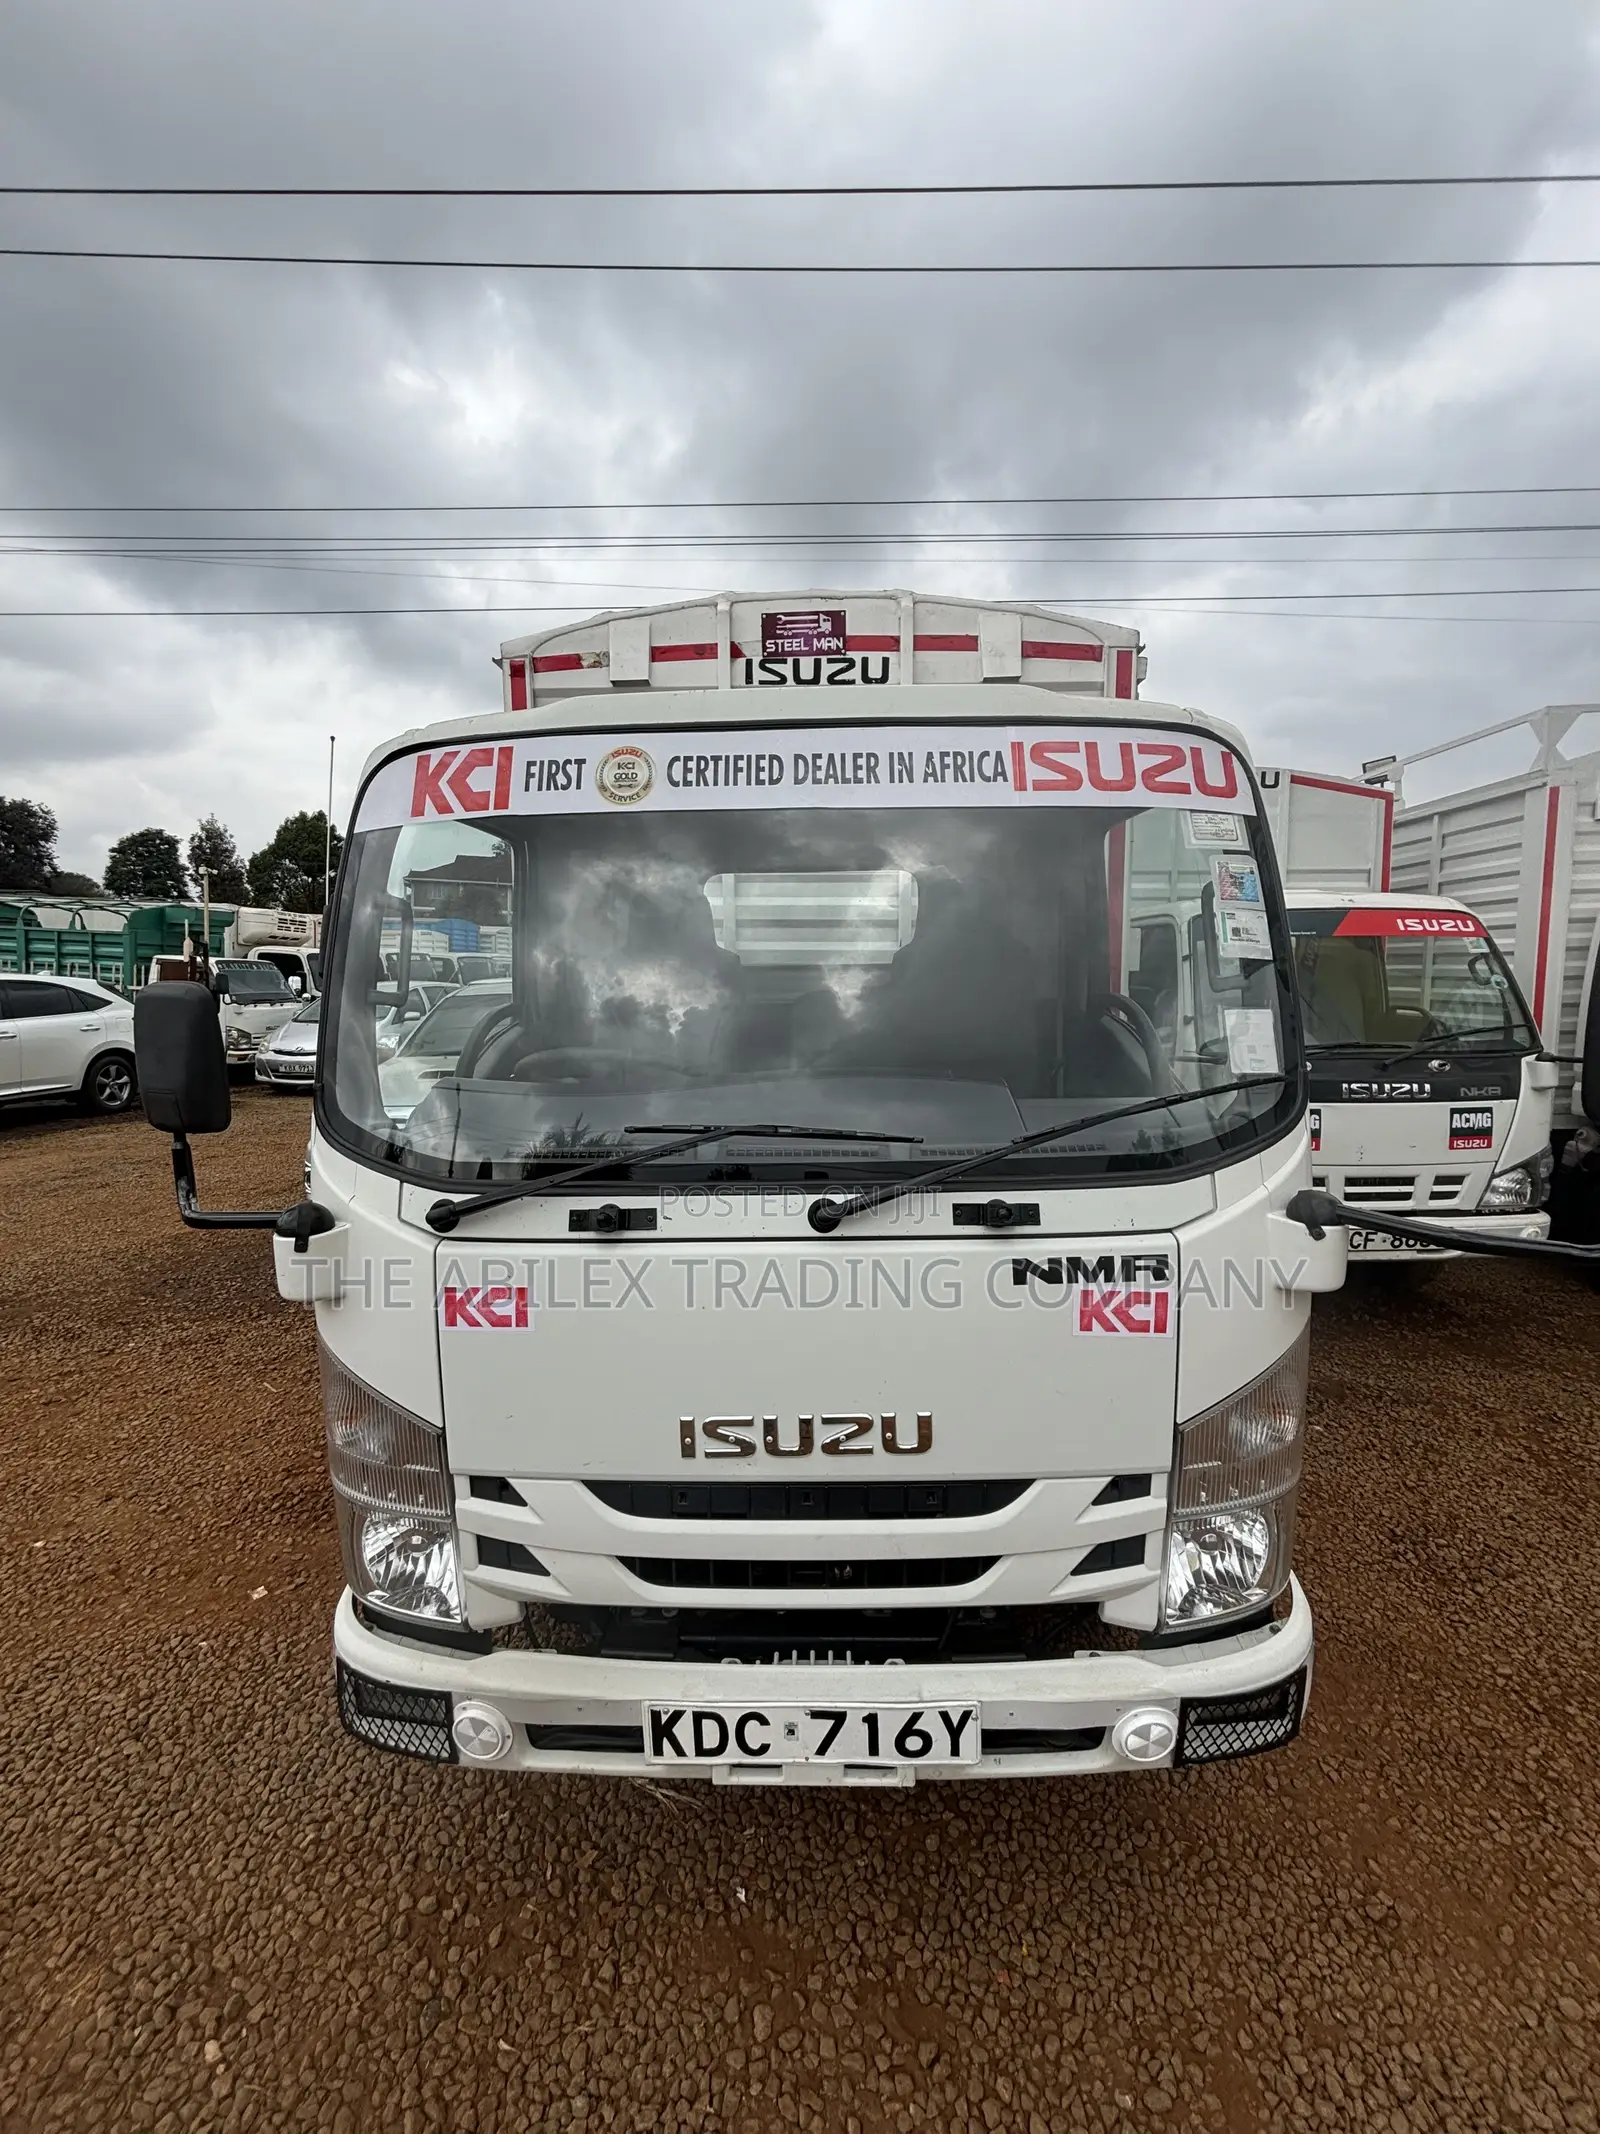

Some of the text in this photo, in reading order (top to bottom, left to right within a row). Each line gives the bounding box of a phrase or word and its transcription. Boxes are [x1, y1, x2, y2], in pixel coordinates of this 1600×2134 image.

[765, 636, 844, 653] STEEL MAN
[745, 656, 890, 685] ISUZU
[611, 748, 643, 759] ISUZU
[617, 762, 635, 770] KCI
[411, 746, 514, 818] KCI
[523, 758, 587, 792] FIRST
[667, 753, 785, 788] CERTIFIED
[793, 752, 880, 786] DEALER
[889, 752, 915, 784] IN
[923, 750, 1009, 784] AFRICA
[1010, 741, 1239, 799] ISUZU
[613, 772, 638, 781] GOLD
[609, 791, 641, 802] SERVICE
[1396, 918, 1476, 932] ISUZU
[1342, 1083, 1431, 1098] ISUZU
[1460, 1086, 1502, 1097] NKR
[1452, 1112, 1492, 1131] ACMG
[1454, 1139, 1488, 1149] ISUZU
[1349, 1231, 1378, 1249] CF
[1011, 1254, 1170, 1285] NMR
[444, 1286, 529, 1328] KCI
[1079, 1289, 1168, 1334] KCI
[679, 1411, 932, 1459] ISUZU
[650, 1709, 974, 1758] KDC 716Y
